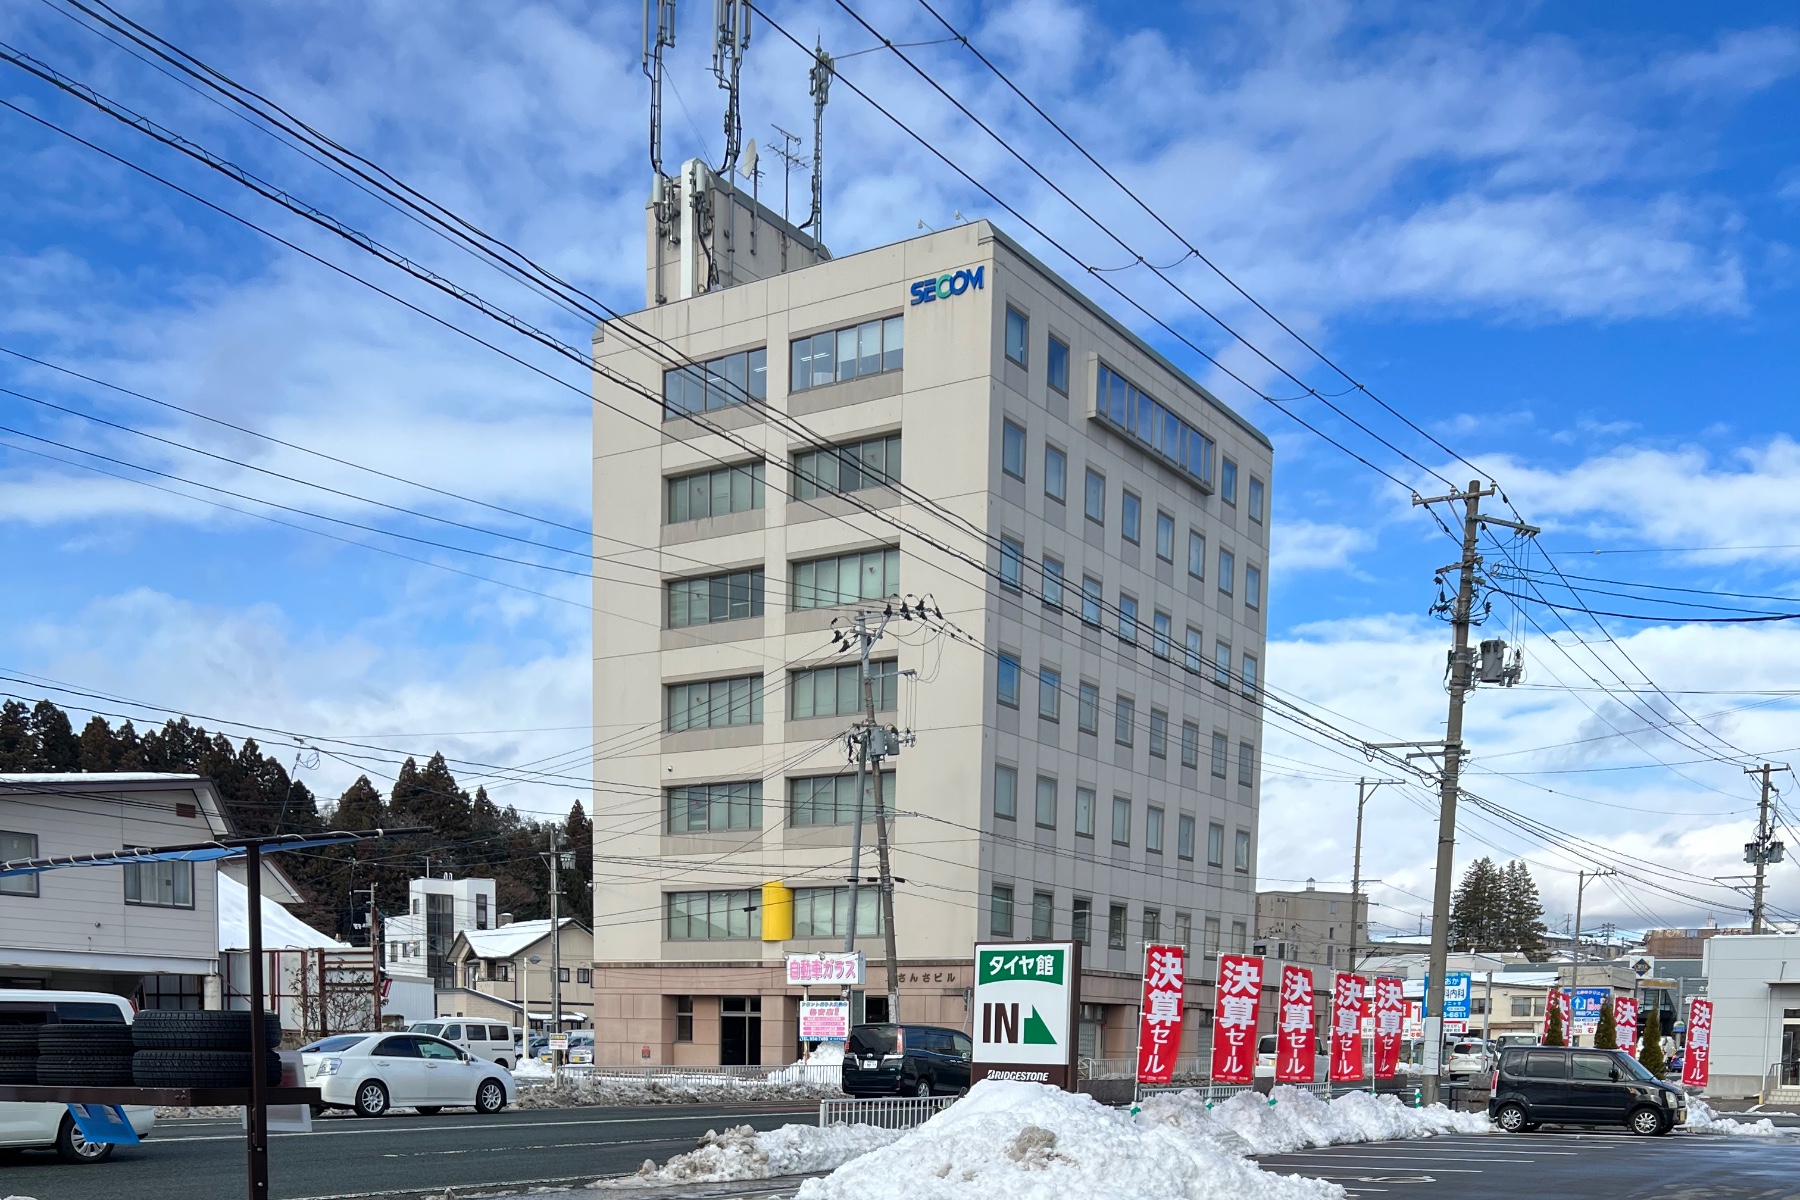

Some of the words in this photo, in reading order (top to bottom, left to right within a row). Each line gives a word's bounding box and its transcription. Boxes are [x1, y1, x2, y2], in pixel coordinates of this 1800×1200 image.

[910, 265, 985, 306] SECOM
[789, 959, 856, 980] 自動車ガラス
[898, 972, 956, 983] さんさビル
[989, 955, 1054, 976] タイヤ館
[982, 1003, 1019, 1043] IN
[1145, 952, 1183, 1074] 決算セール
[1219, 960, 1260, 1074] 決算セール
[1281, 971, 1313, 1075] 決算セール
[1336, 978, 1363, 1075] 決算セール
[1377, 982, 1403, 1073] 決算セール
[1615, 1000, 1636, 1053] 決算
[1689, 1003, 1710, 1080] 決算セール
[987, 1069, 1049, 1081] BRIDGESTONE
